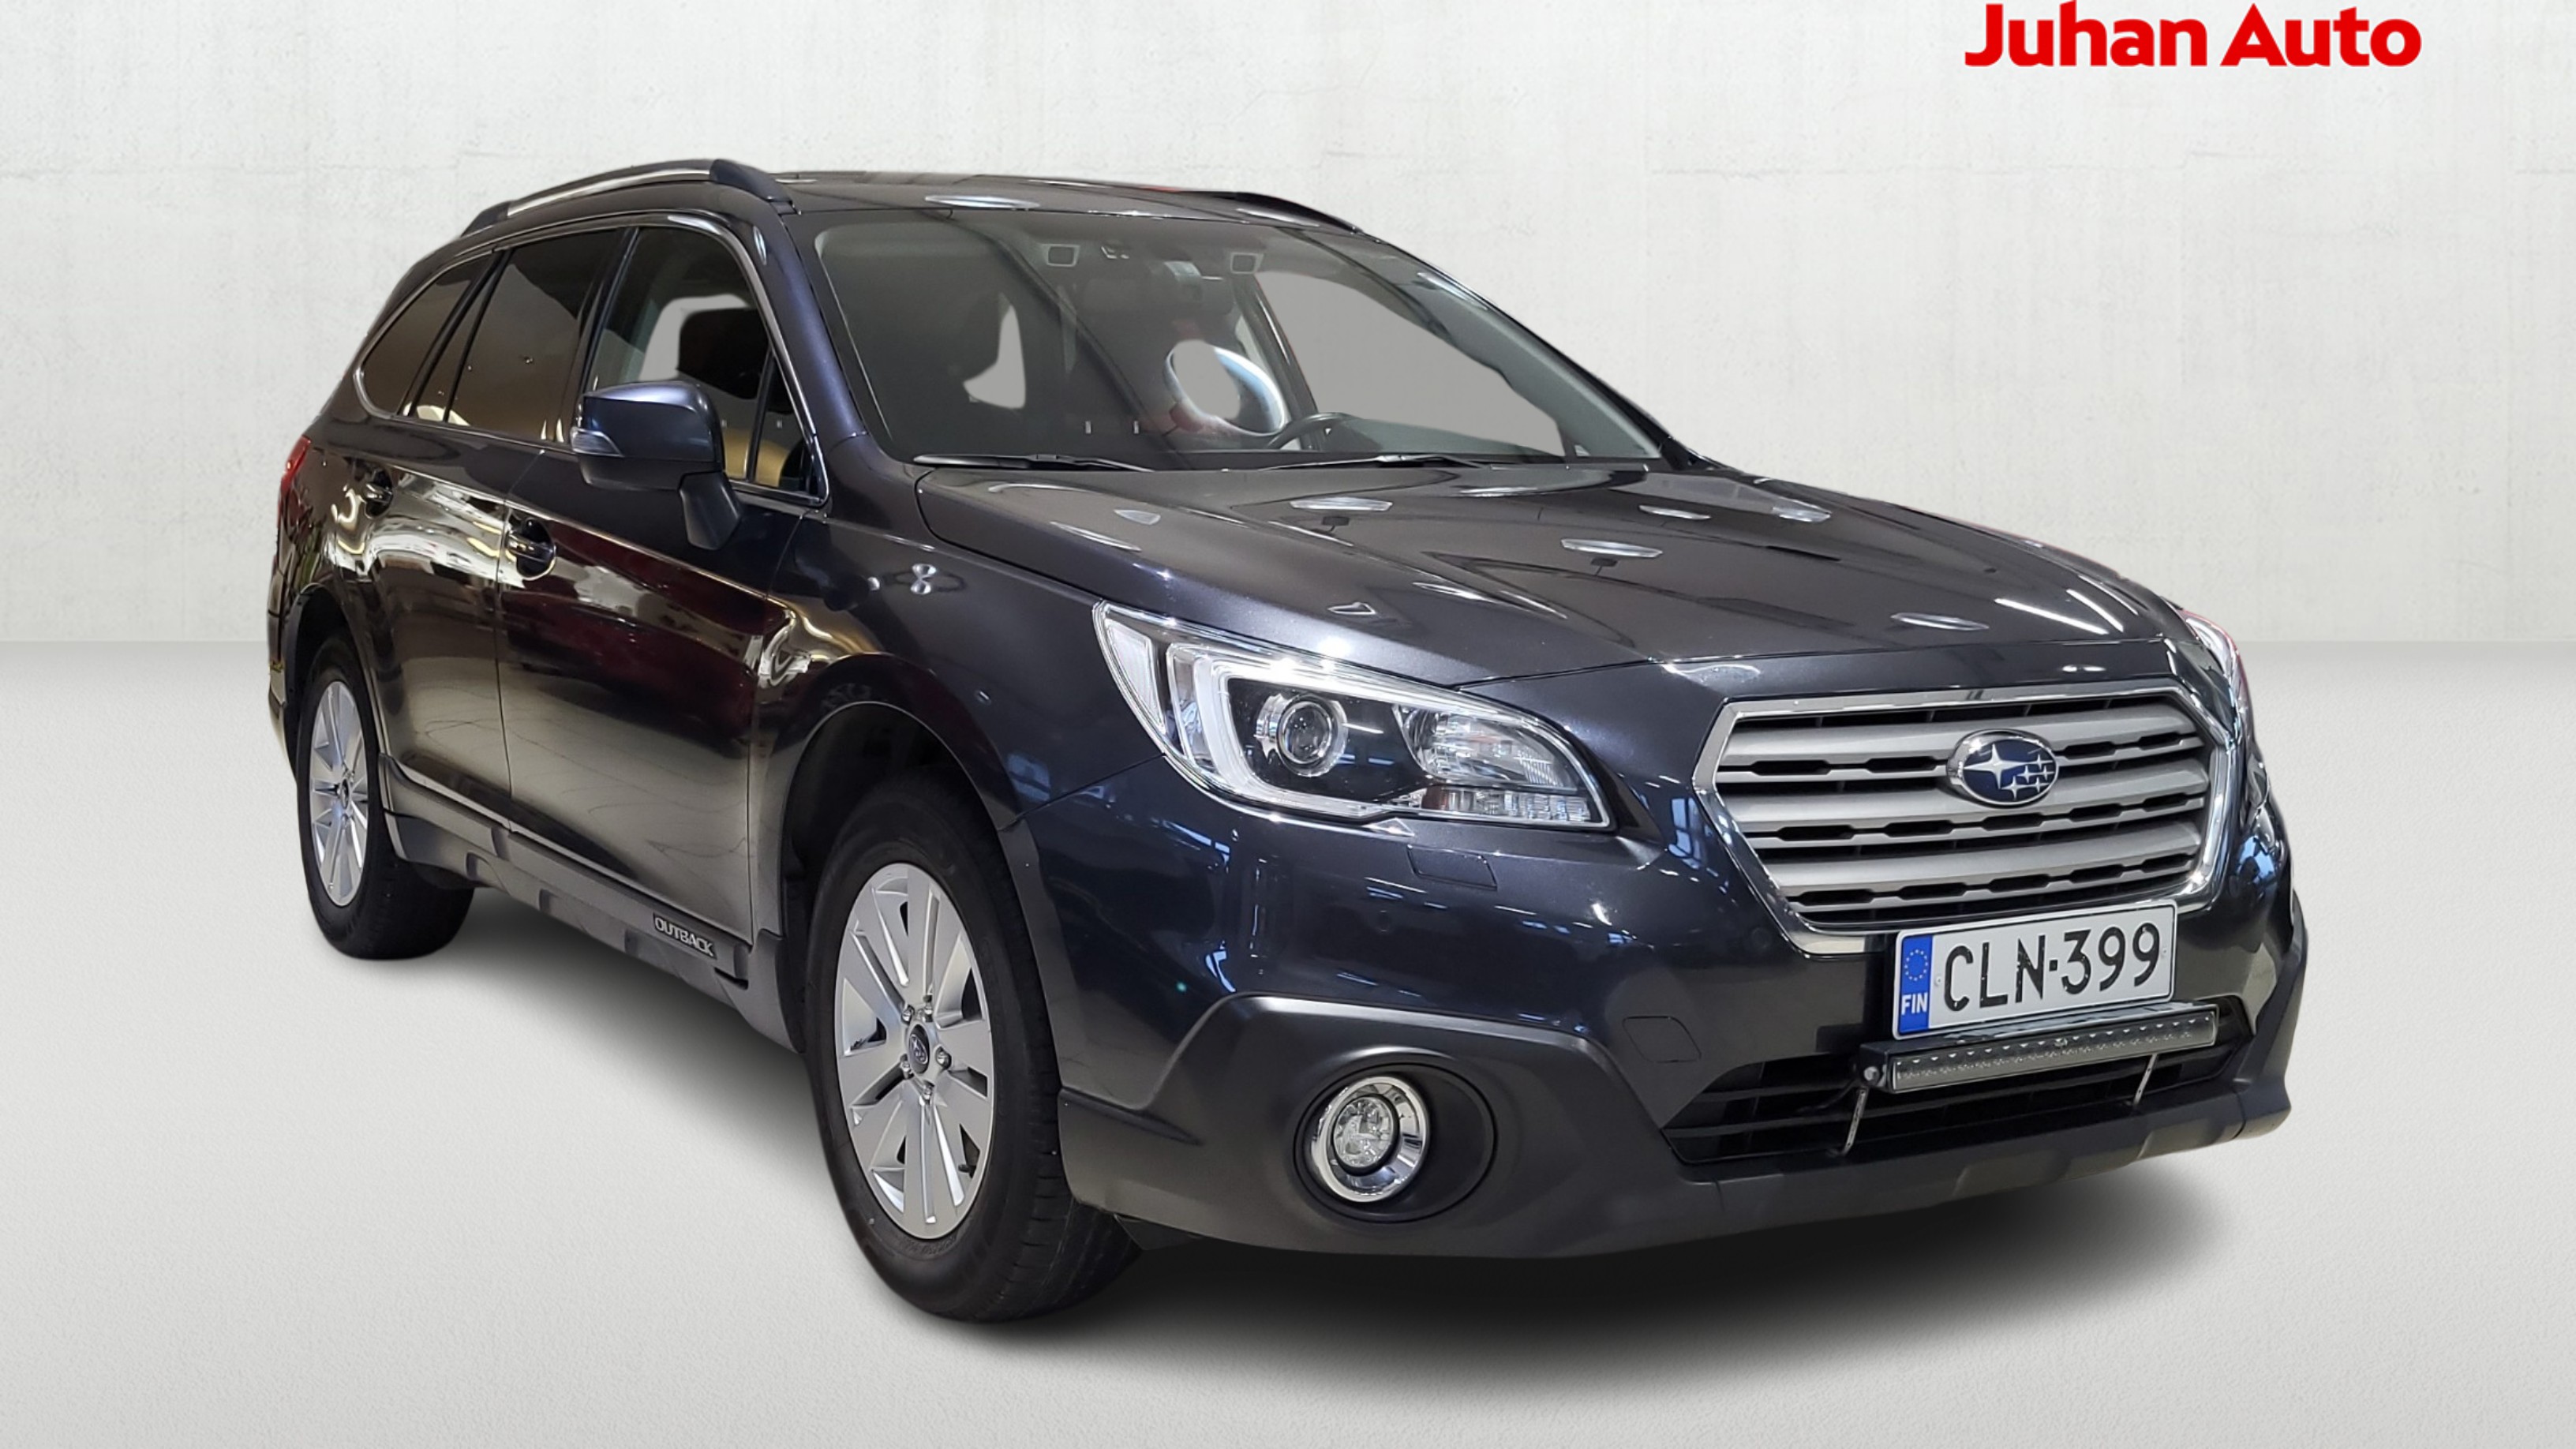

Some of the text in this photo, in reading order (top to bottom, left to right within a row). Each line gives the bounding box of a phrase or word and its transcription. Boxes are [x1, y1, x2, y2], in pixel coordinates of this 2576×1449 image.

[654, 917, 713, 957] OUTBACK
[1944, 923, 2160, 1012] CLN-399
[1901, 992, 1927, 1015] FIN
